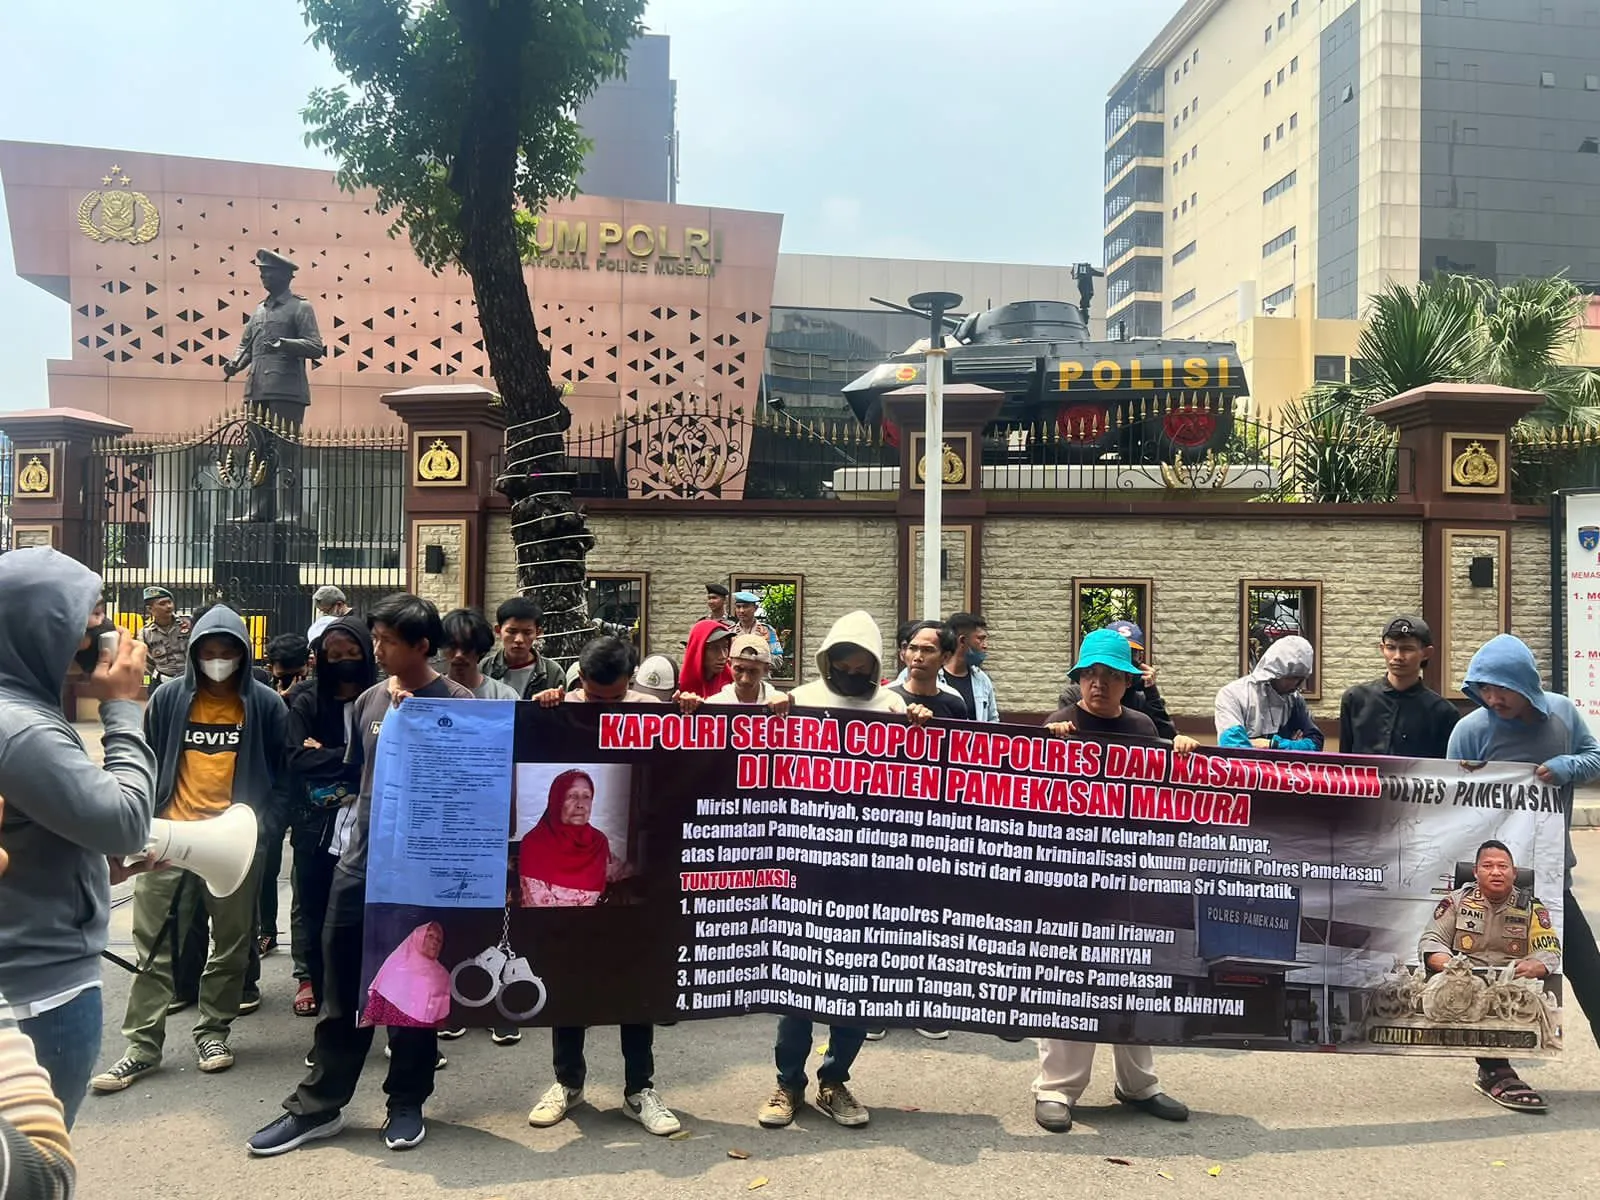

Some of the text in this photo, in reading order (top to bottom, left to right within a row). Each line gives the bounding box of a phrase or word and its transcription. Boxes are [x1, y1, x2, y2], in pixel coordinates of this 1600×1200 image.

[534, 219, 724, 263] UM POLRI
[522, 254, 716, 279] ATIONAL POLICE MUSEUM
[1058, 357, 1231, 392] POLISI
[599, 713, 1382, 799] KAPOLRI SEGERA COPOT KAPOLRES DAN KASATRESKRIM
[737, 754, 1252, 827] DI KABUPATEN PAMEKASAN MADURA
[1379, 775, 1565, 814] POLRES PAMEKASAN
[696, 798, 1272, 856] Miris! Nenek Bahriyah, seorang lanjut lansia buta asal Kelurahan Gladak Anyar,
[681, 845, 1297, 900] atas laporan perampasan tanah oleh istri dari anggota Polri bernama Sri Suhartatik.
[682, 820, 1384, 884] Kecamatan Pamekasan diduga menjadi korban kriminalisasi oknum penyidik Polres Pamekasan
[680, 870, 754, 892] TUNTUTAN
[680, 893, 1176, 944] 1. Mendesak Kapolri Copot Kapolres Pamekasan Jazuli Dani Iriawan
[1207, 907, 1289, 930] POLRES PAMEKASAN
[1461, 908, 1484, 920] DANI
[678, 940, 1173, 990] 2. Mendesak Kapolri Segera Copot Kasatreskrim Polres Pamekasan
[695, 917, 1153, 966] Karena Adanya Dugaan Kriminalisasi Kepada Nenek BAHRIYAH
[676, 987, 1099, 1033] 4. Bumi Hanguskan Mafia Tanah di Kabupaten Pamekasan
[677, 963, 1245, 1017] 3. Mendesak Kapolri Wajib Turun Tangan, STOP Kriminalisasi Nenek BAHRIYAH
[1373, 1027, 1412, 1044] JAZULI
